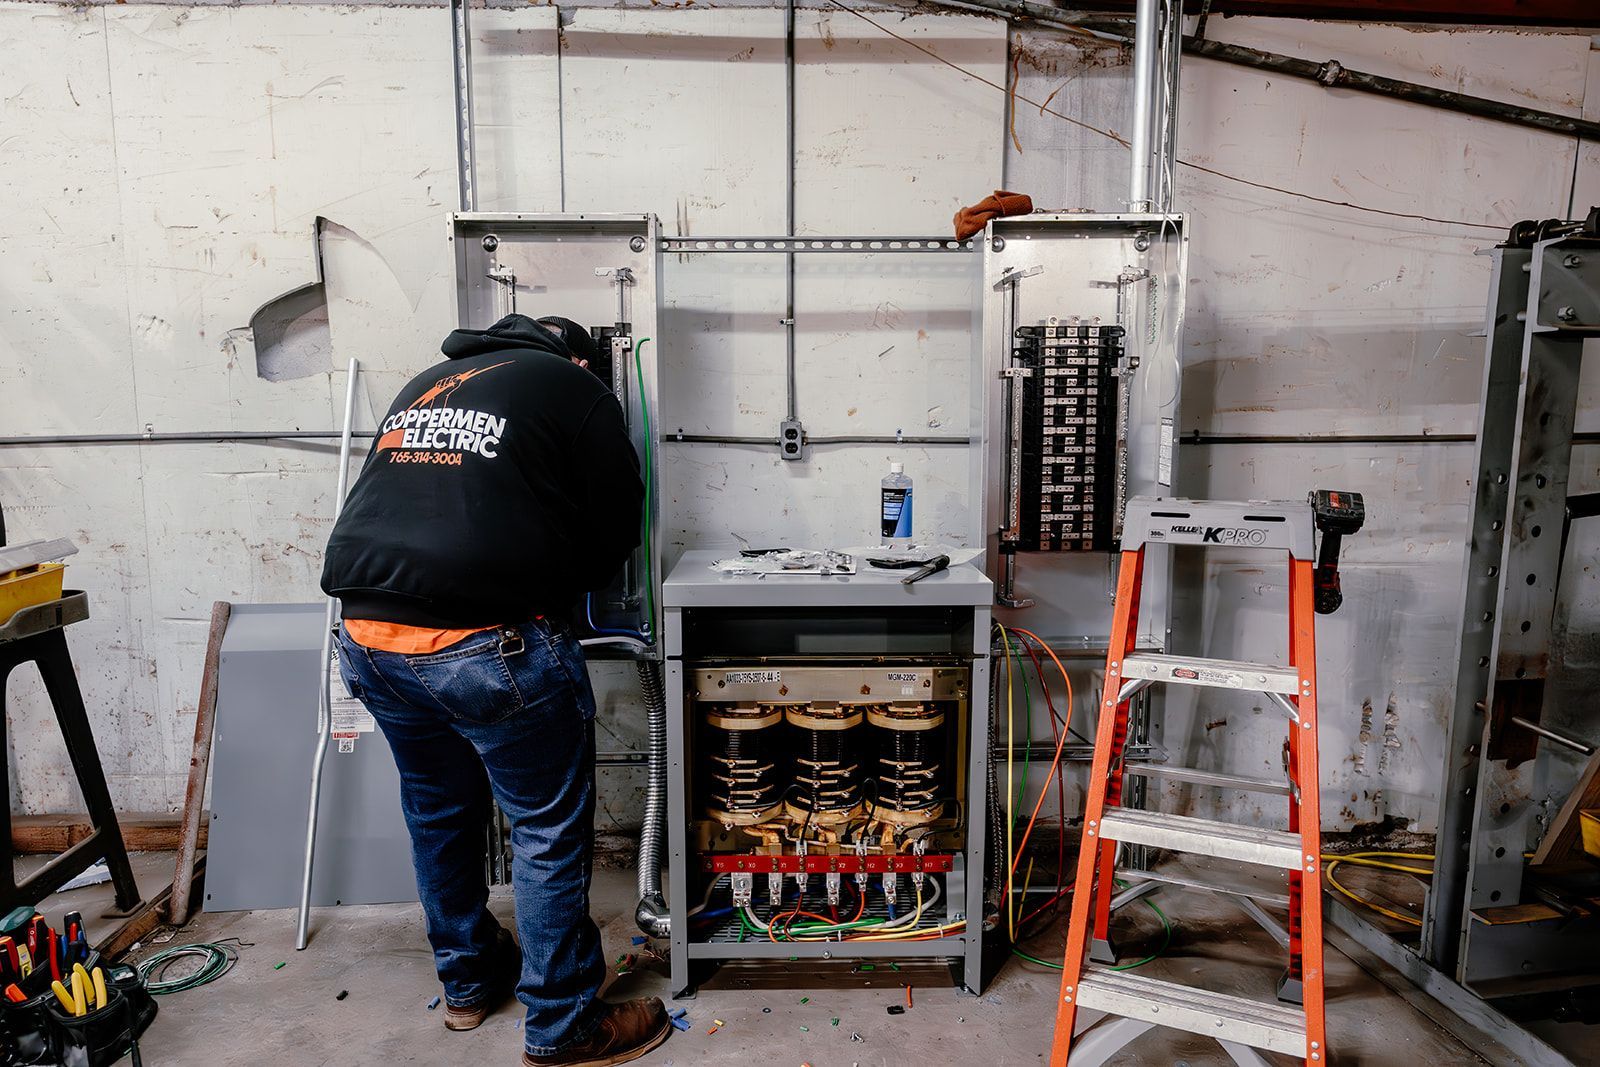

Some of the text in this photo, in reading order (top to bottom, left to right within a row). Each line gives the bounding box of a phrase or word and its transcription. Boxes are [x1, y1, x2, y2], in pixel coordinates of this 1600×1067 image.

[382, 408, 507, 438] COPPERMEN
[401, 427, 500, 459] ELECTRIC
[389, 452, 463, 466] 765-314-3004
